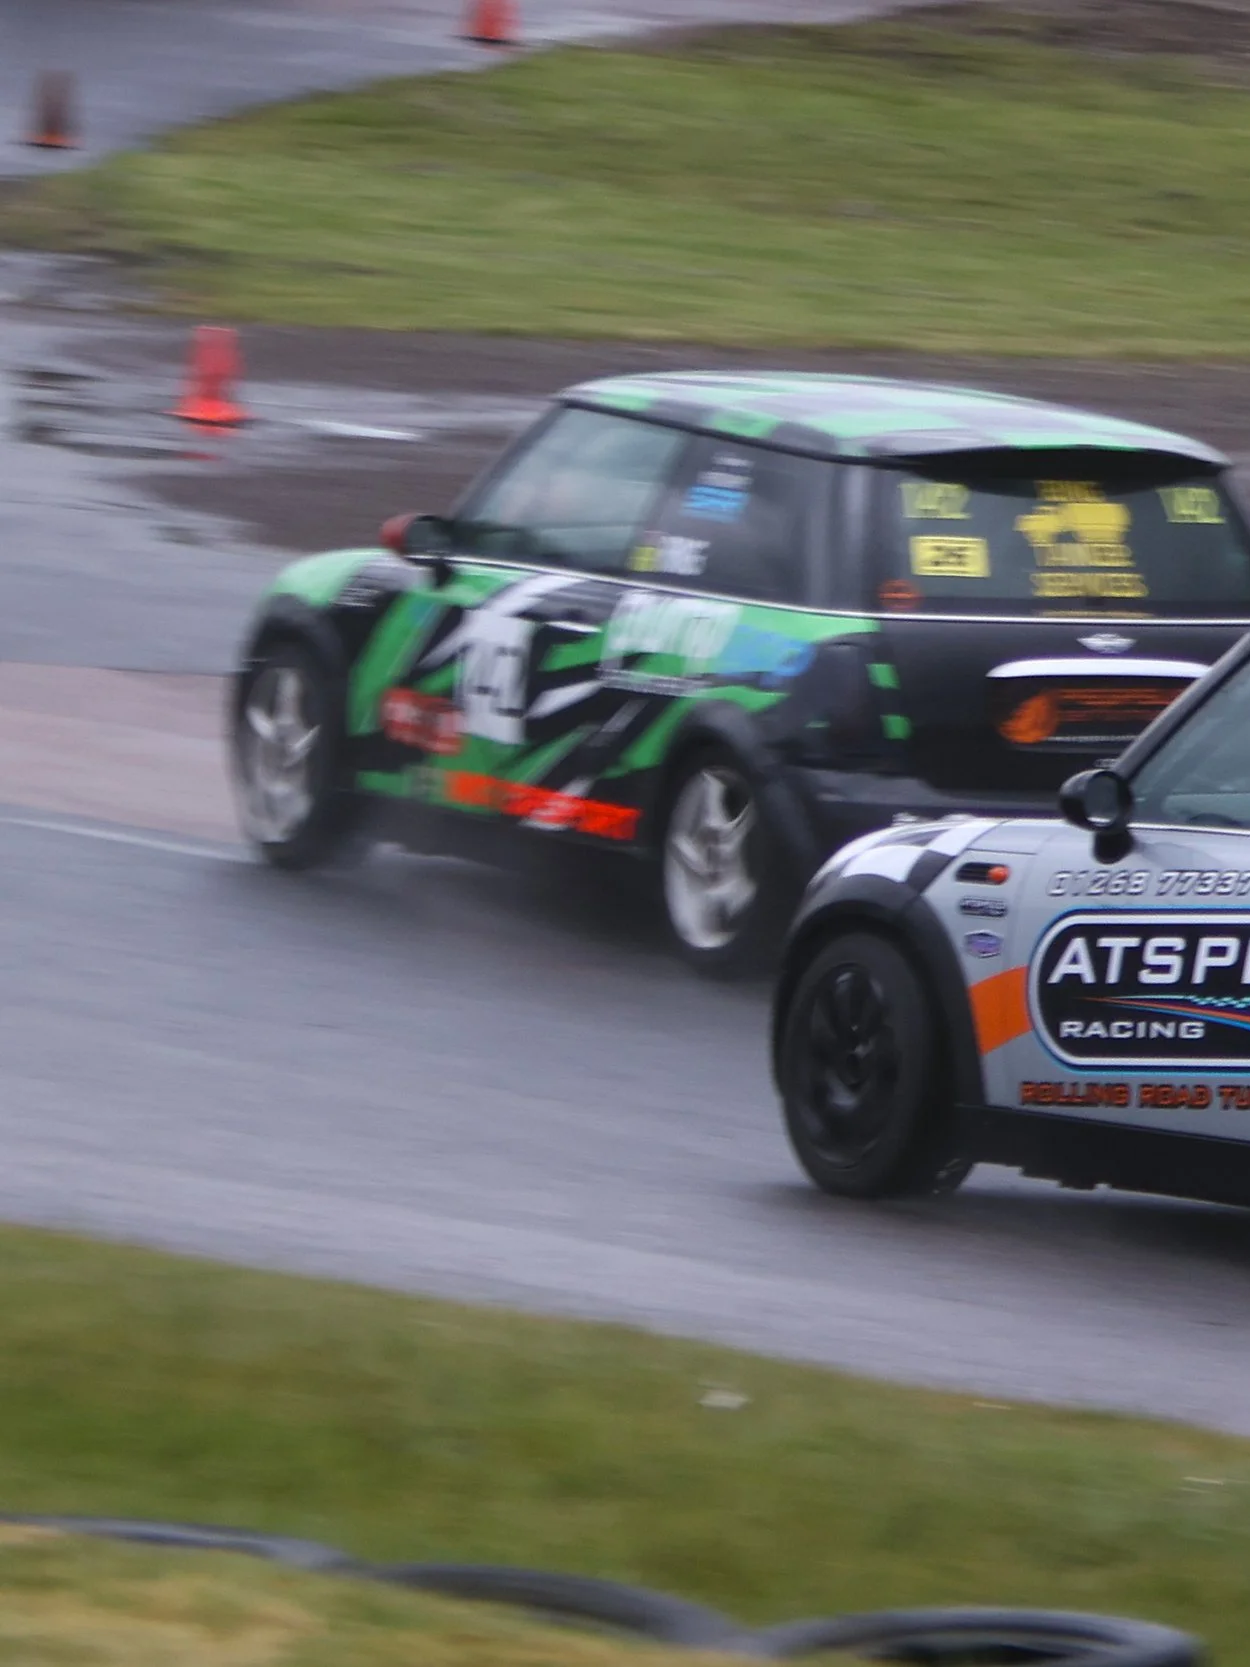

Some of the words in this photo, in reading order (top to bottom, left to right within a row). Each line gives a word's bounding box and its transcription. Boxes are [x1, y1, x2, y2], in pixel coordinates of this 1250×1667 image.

[1047, 870, 1149, 896] 01268
[1059, 1020, 1205, 1039] RACING
[1020, 1081, 1133, 1109] ROLLING
[1138, 1083, 1213, 1110] ROAD
